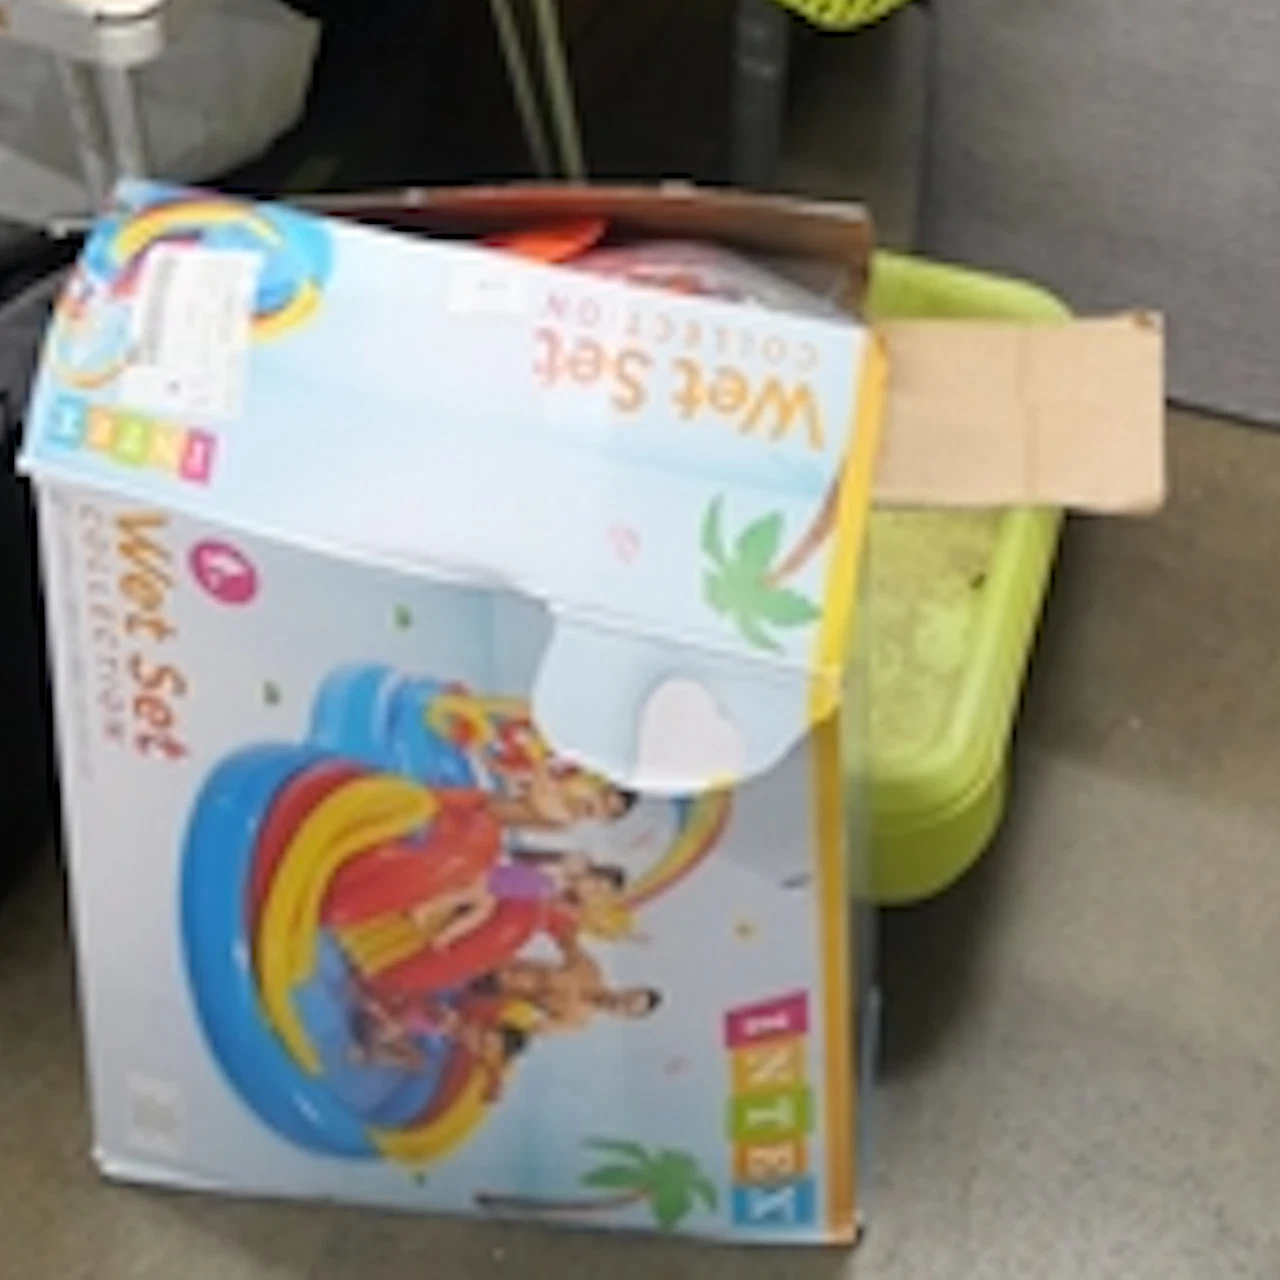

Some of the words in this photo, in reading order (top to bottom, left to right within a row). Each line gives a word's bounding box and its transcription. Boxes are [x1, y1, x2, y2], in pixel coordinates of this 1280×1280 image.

[532, 328, 653, 415] Set
[670, 357, 826, 452] Wet
[115, 513, 179, 643] Wet
[128, 651, 190, 761] Set
[734, 1000, 806, 1225] INTEX
